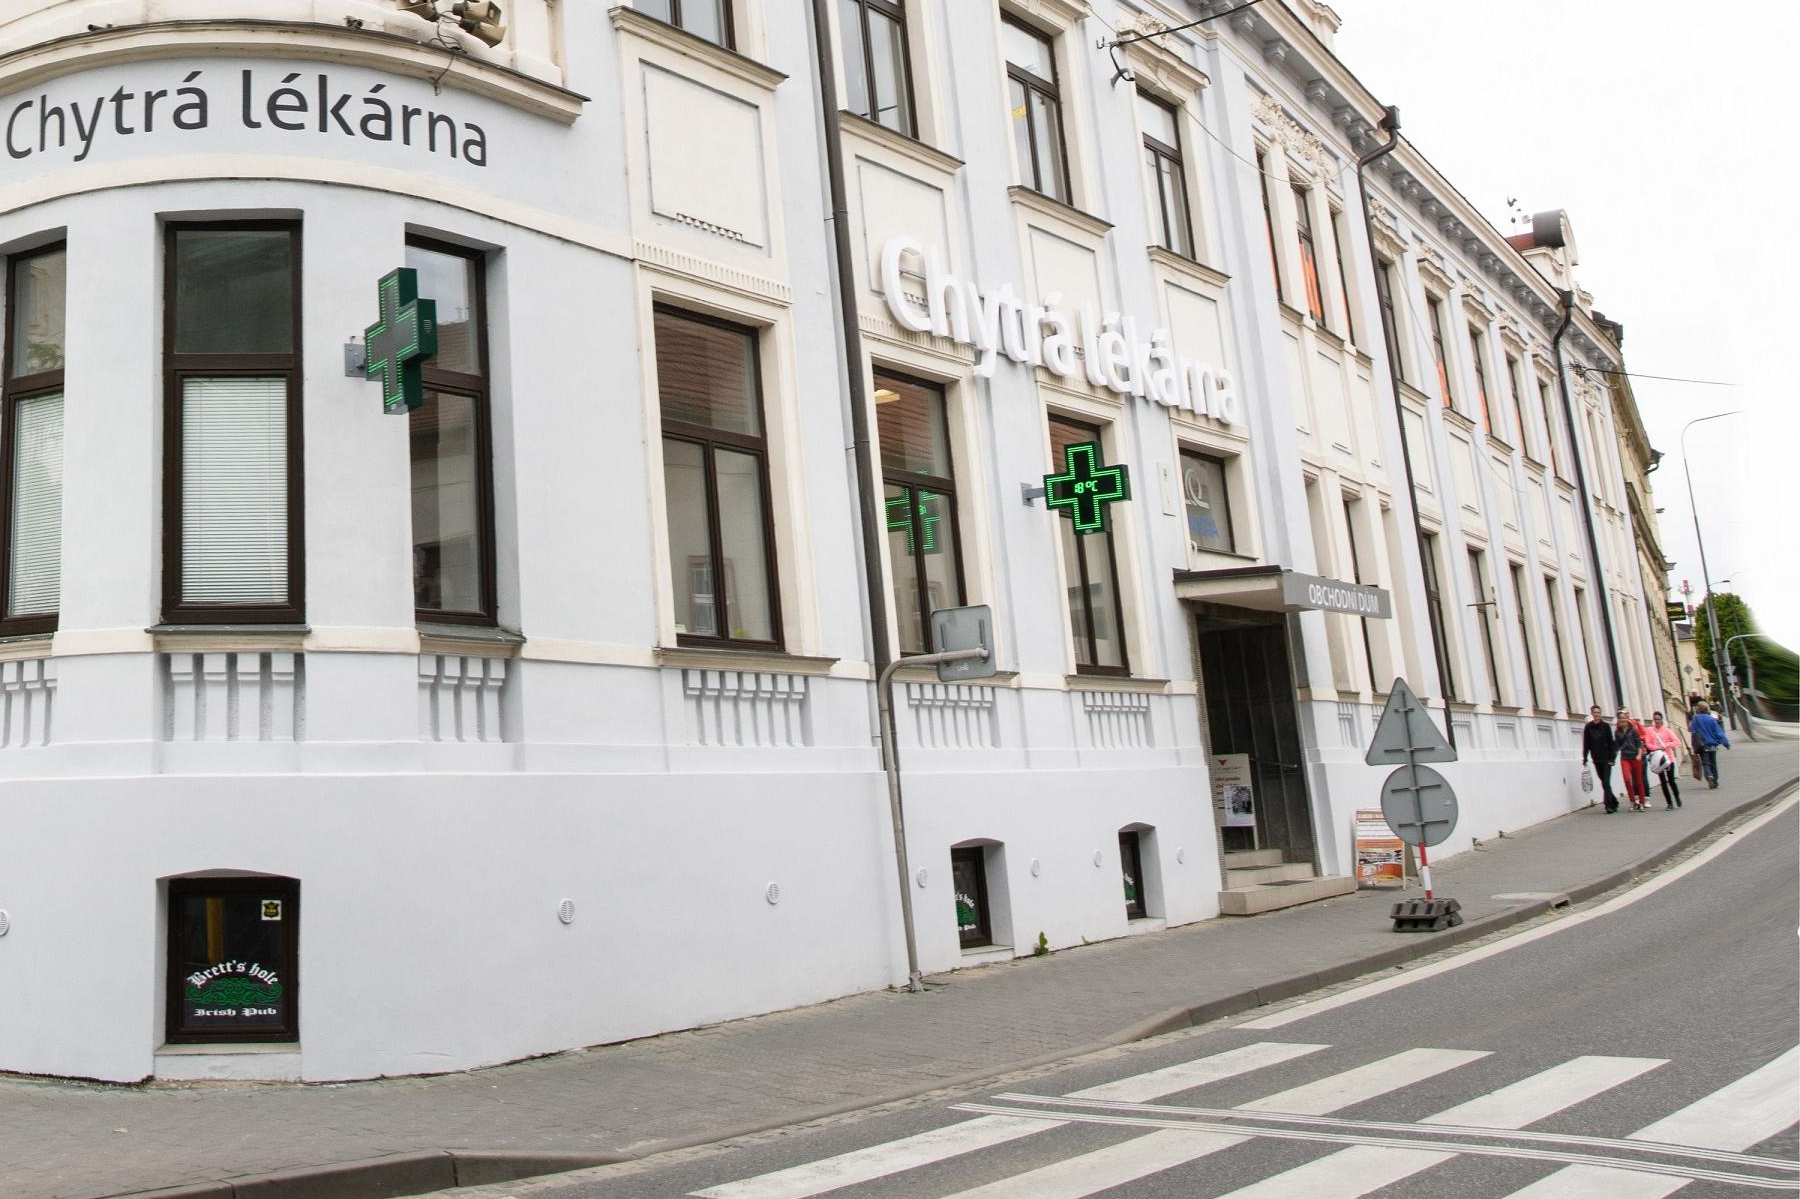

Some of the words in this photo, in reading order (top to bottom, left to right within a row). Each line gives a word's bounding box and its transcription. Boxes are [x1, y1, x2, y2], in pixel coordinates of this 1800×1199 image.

[6, 70, 209, 162] Chytrá
[242, 69, 488, 168] lékárna
[881, 236, 1076, 378] Chytrá
[1077, 301, 1237, 425] lékárna
[1308, 583, 1358, 610] OBCHODNÍ
[1358, 588, 1380, 614] DŮM
[187, 959, 247, 989] Brett's
[248, 962, 279, 985] hole
[193, 1008, 237, 1017] Irish
[241, 1007, 277, 1017] Pub
